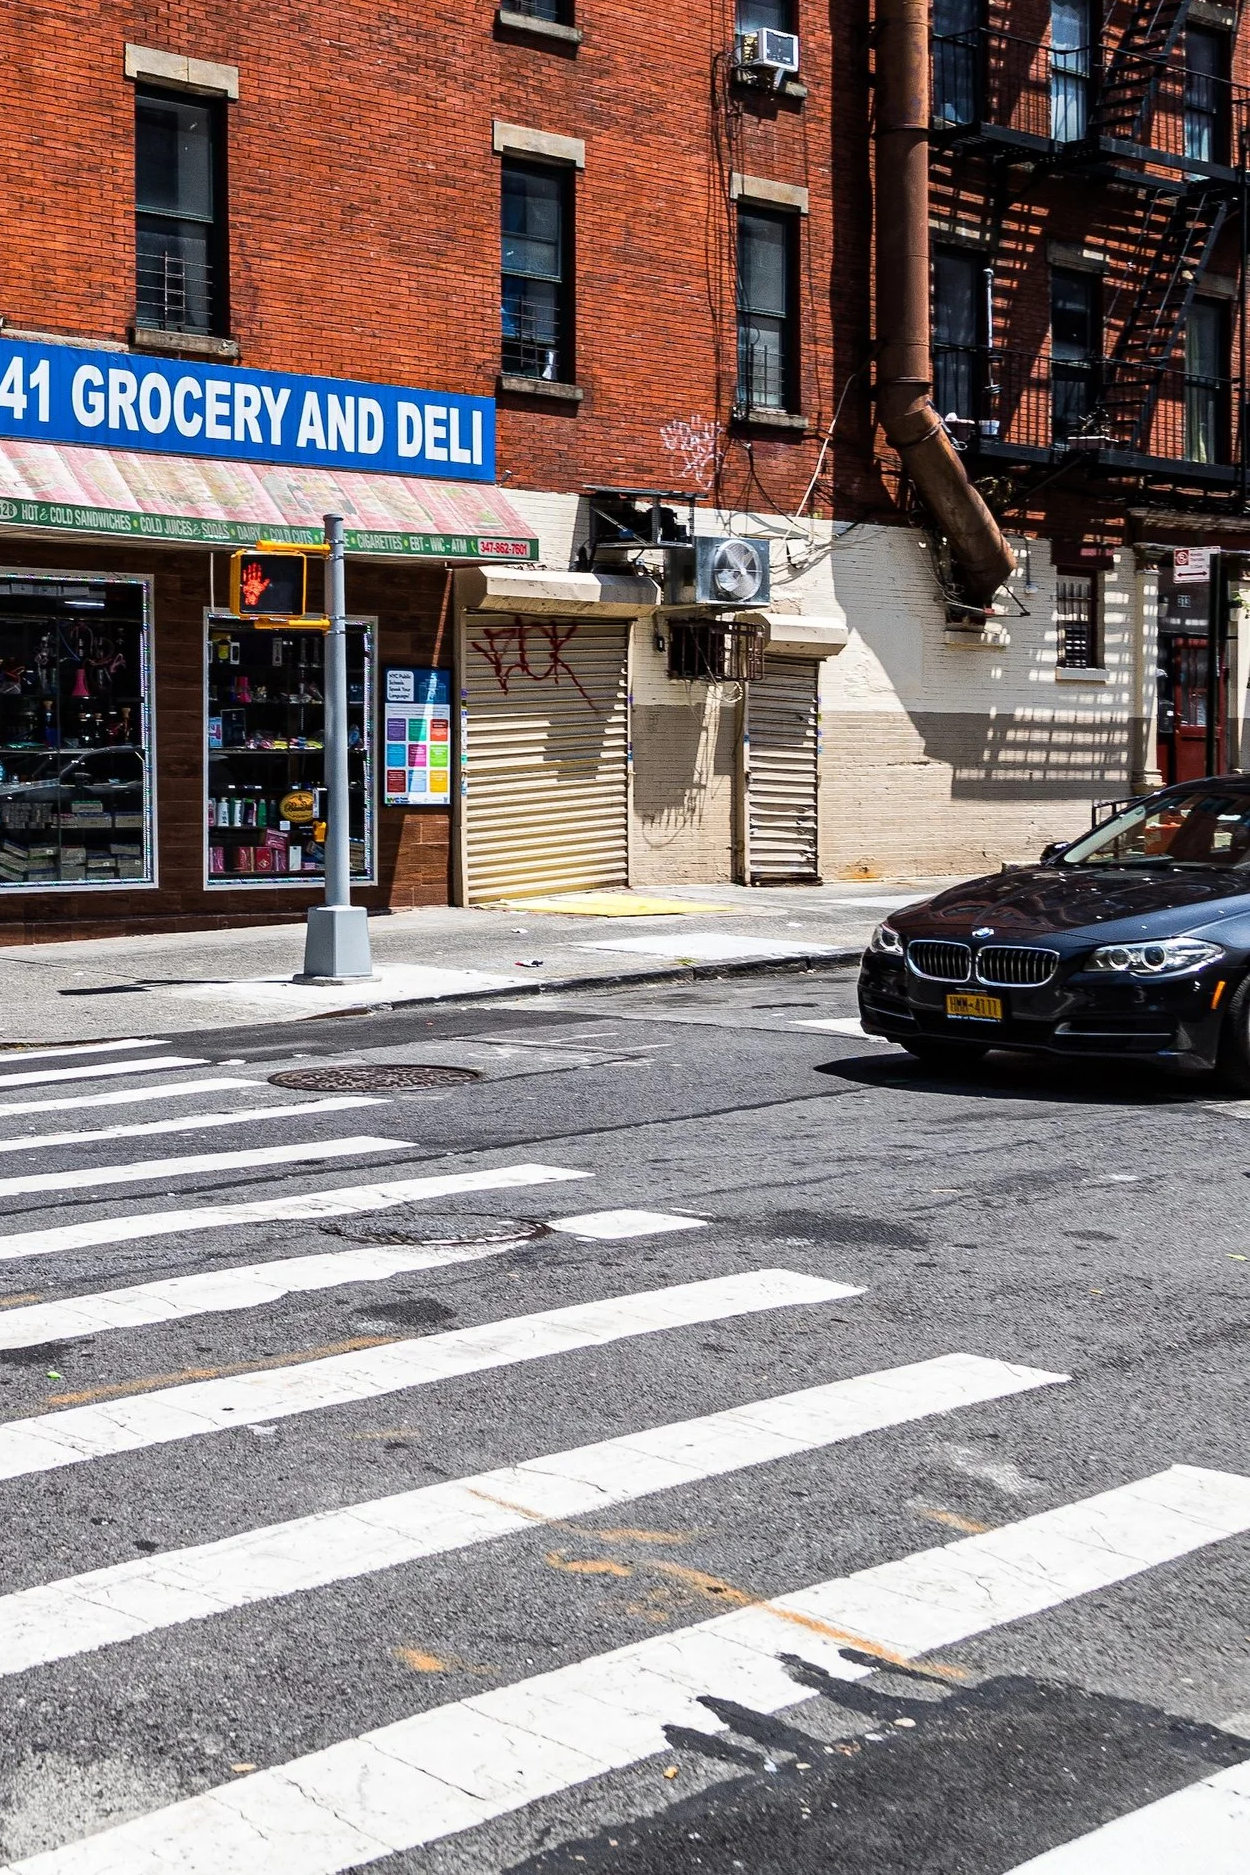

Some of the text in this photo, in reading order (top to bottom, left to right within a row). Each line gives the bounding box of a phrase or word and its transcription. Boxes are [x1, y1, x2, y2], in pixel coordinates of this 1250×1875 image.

[71, 364, 291, 446] GROCERY
[296, 390, 385, 455] AND
[397, 400, 483, 466] DELI
[21, 503, 39, 522] HOT
[50, 507, 73, 525] COLD
[74, 509, 132, 532] SANDWICHES
[139, 516, 163, 534] COLD
[164, 519, 193, 537] JUICES
[201, 521, 229, 538] SODAS
[237, 524, 262, 541] DAIRY
[269, 527, 291, 543] COLD
[291, 528, 313, 544] CUTS
[356, 533, 403, 551] CIGARETTES
[409, 535, 425, 552] EBT
[430, 536, 446, 553] WIC
[451, 537, 468, 554] ATM
[479, 540, 528, 557] 347-862-7601
